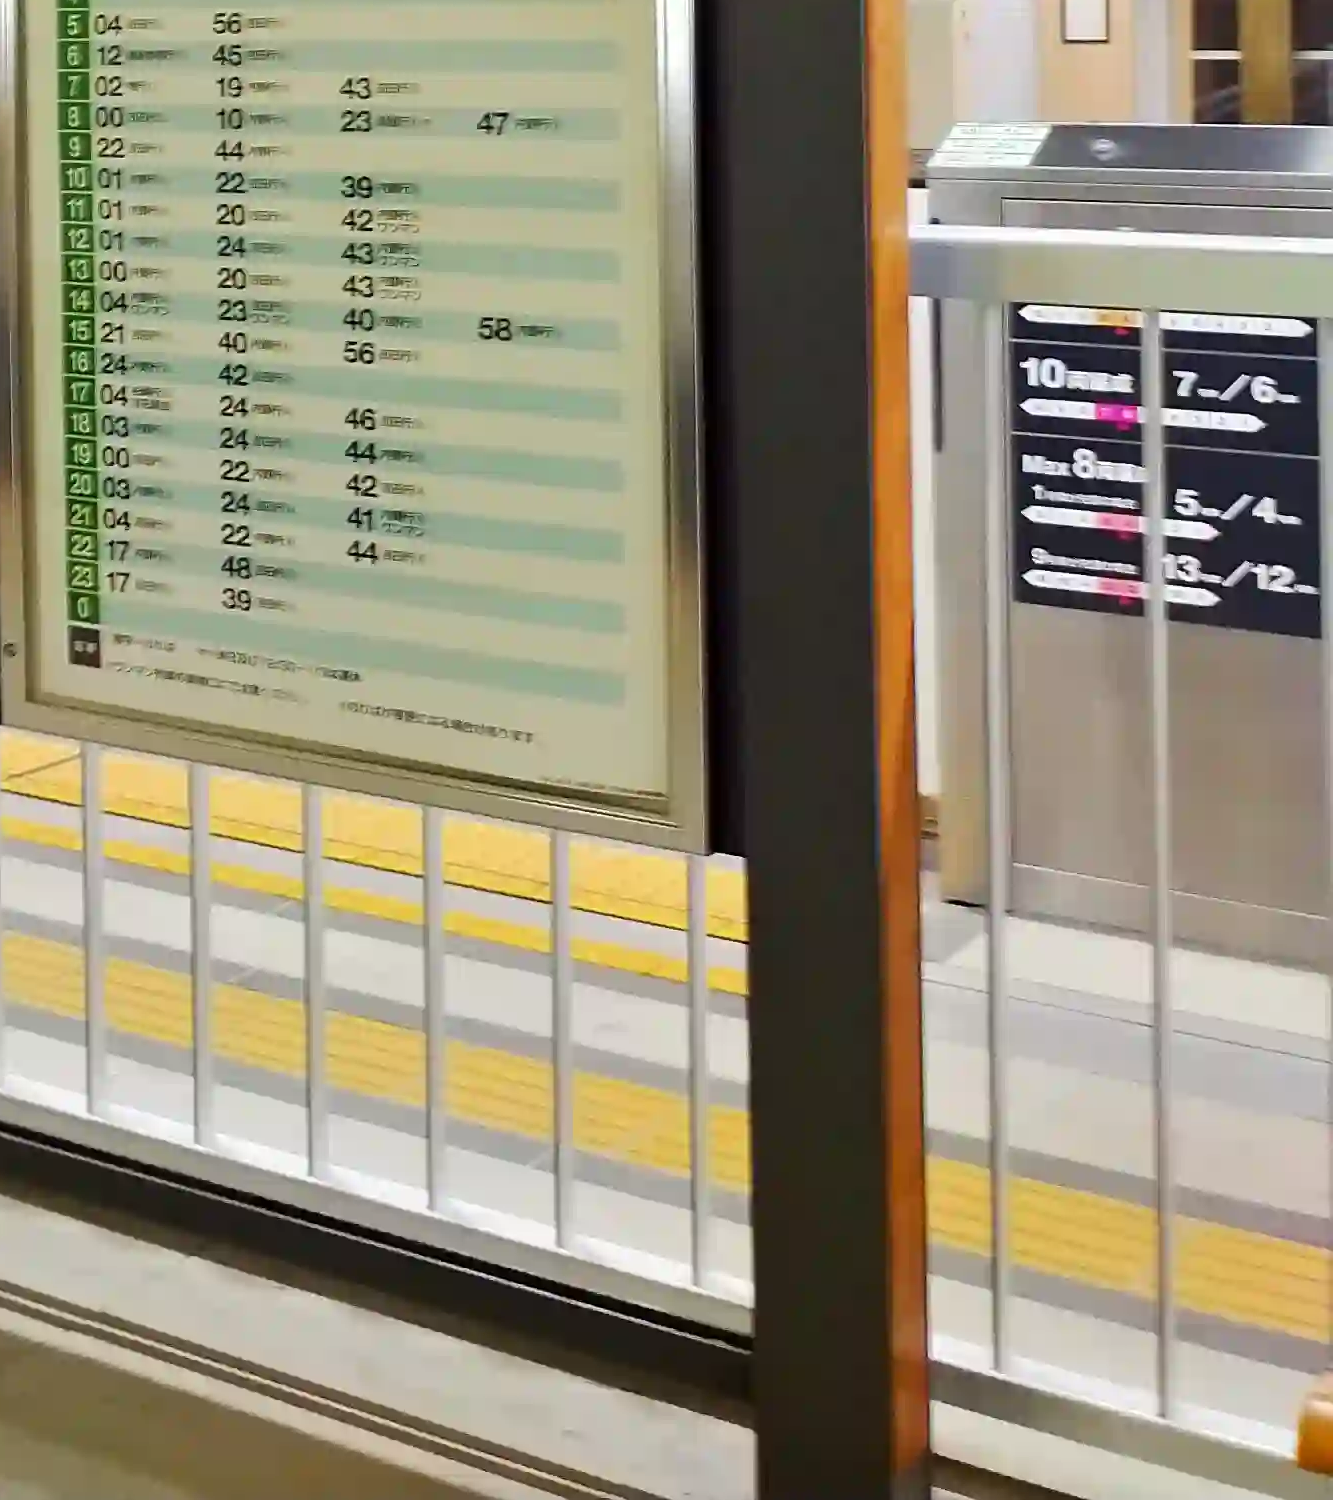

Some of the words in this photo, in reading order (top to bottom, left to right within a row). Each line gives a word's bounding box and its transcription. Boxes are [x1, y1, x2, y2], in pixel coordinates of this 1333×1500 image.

[67, 16, 80, 34] 5
[94, 14, 122, 35] 04
[213, 12, 242, 34] 56
[67, 48, 79, 66] 6
[99, 45, 122, 65] 12
[213, 44, 242, 66] 45
[67, 79, 80, 97] 7
[95, 76, 122, 97] 02
[217, 77, 242, 98] 19
[340, 78, 371, 99] 43
[96, 106, 123, 128] 00
[217, 108, 243, 129] 10
[341, 109, 372, 132] 23
[477, 112, 509, 135] 47
[69, 139, 81, 157] 9
[97, 138, 125, 158] 22
[214, 140, 245, 161] 44
[98, 169, 121, 189] 01
[216, 172, 246, 193] 22
[341, 176, 372, 198] 39
[66, 199, 83, 217] 11
[98, 200, 121, 220] 01
[216, 204, 245, 225] 20
[341, 209, 373, 232] 42
[68, 230, 89, 249] 12
[100, 230, 123, 251] 01
[217, 236, 246, 257] 24
[342, 243, 374, 265] 43
[68, 261, 89, 280] 13
[99, 261, 126, 282] 00
[217, 268, 246, 289] 20
[342, 276, 373, 298] 43
[69, 292, 92, 310] 14
[101, 291, 127, 314] 04
[218, 299, 247, 322] 23
[343, 309, 374, 331] 40
[478, 318, 512, 341] 58
[69, 319, 92, 335] 15
[101, 323, 124, 343] 21
[218, 332, 246, 354] 40
[343, 342, 375, 364] 56
[69, 350, 91, 372] 16
[101, 353, 127, 374] 24
[219, 364, 248, 386] 42
[69, 382, 91, 403] 17
[101, 384, 128, 406] 04
[220, 395, 248, 417] 24
[345, 407, 376, 430] 46
[69, 413, 91, 433] 18
[101, 415, 128, 437] 03
[220, 428, 249, 449] 24
[345, 441, 377, 463] 44
[69, 443, 91, 464] 19
[102, 446, 129, 469] 00
[221, 459, 250, 482] 22
[346, 475, 377, 498] 42
[70, 473, 91, 495] 20
[103, 477, 130, 499] 03
[221, 492, 250, 513] 24
[347, 508, 372, 530] 41
[70, 506, 91, 526] 21
[104, 508, 130, 530] 04
[221, 524, 251, 546] 22
[347, 540, 377, 563] 44
[71, 536, 92, 558] 22
[107, 541, 129, 561] 17
[221, 557, 251, 578] 48
[107, 572, 130, 592] 17
[222, 588, 251, 611] 39
